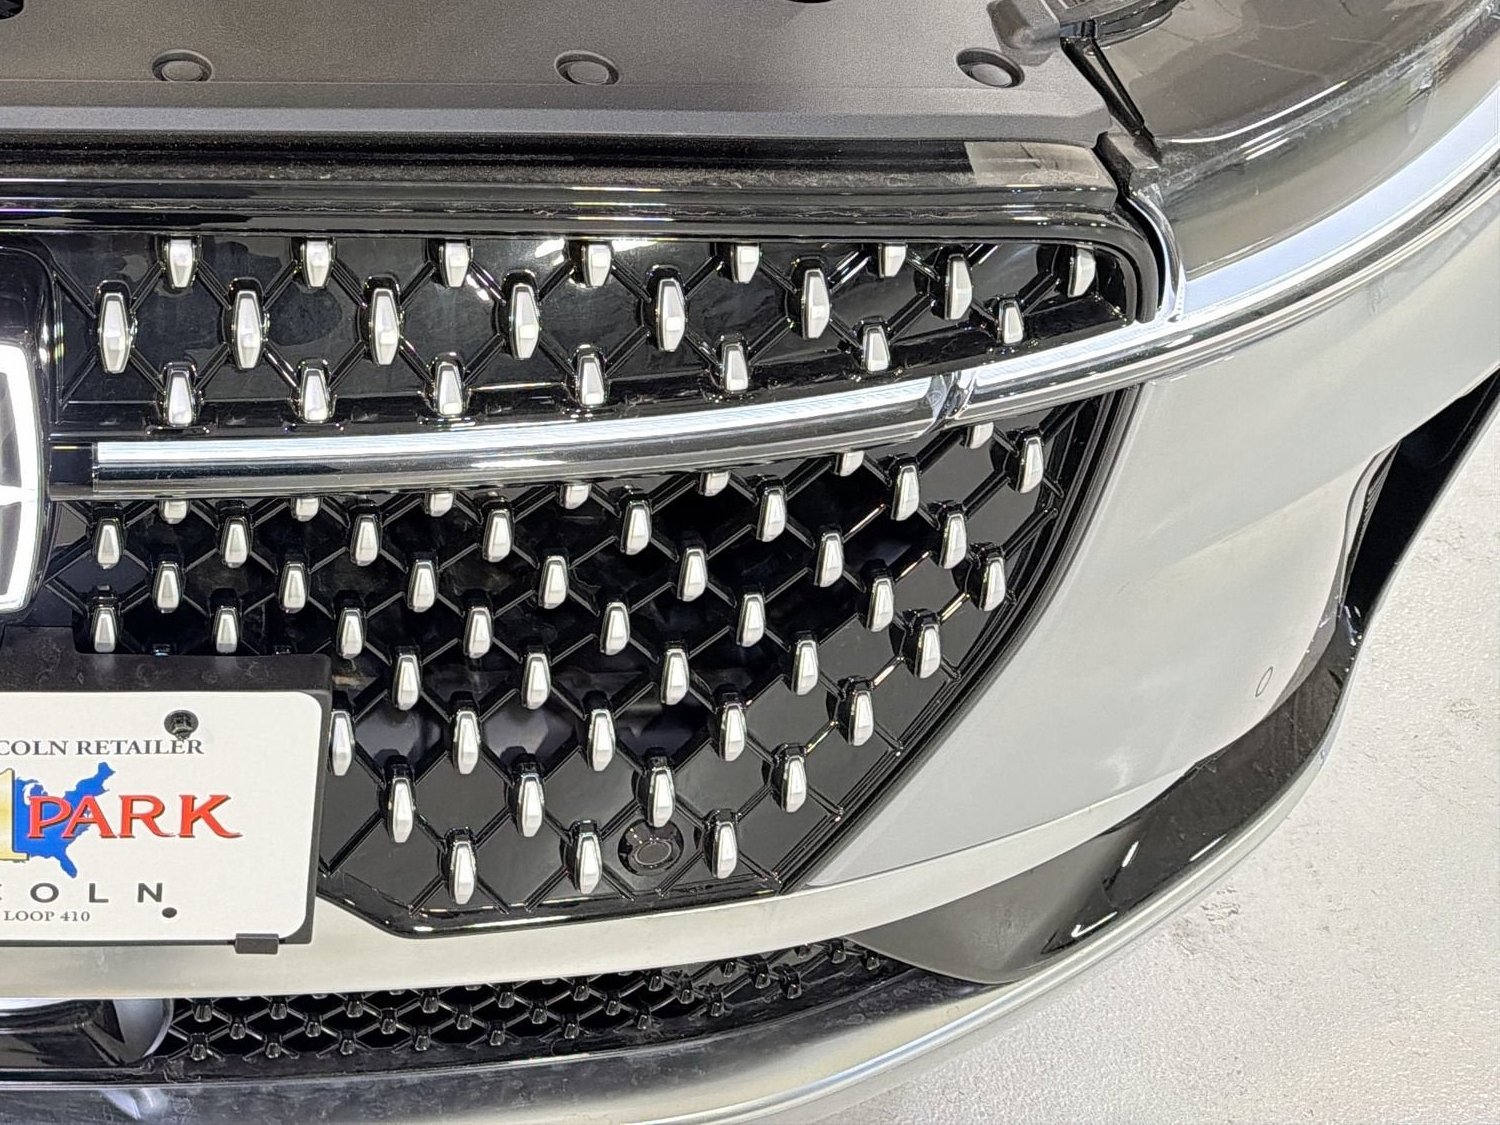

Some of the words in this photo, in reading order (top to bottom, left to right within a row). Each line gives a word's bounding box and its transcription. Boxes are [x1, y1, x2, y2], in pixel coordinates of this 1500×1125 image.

[76, 738, 205, 755] RETAILER
[27, 793, 244, 839] PARK
[3, 910, 56, 922] LOOP
[60, 911, 91, 923] 410
